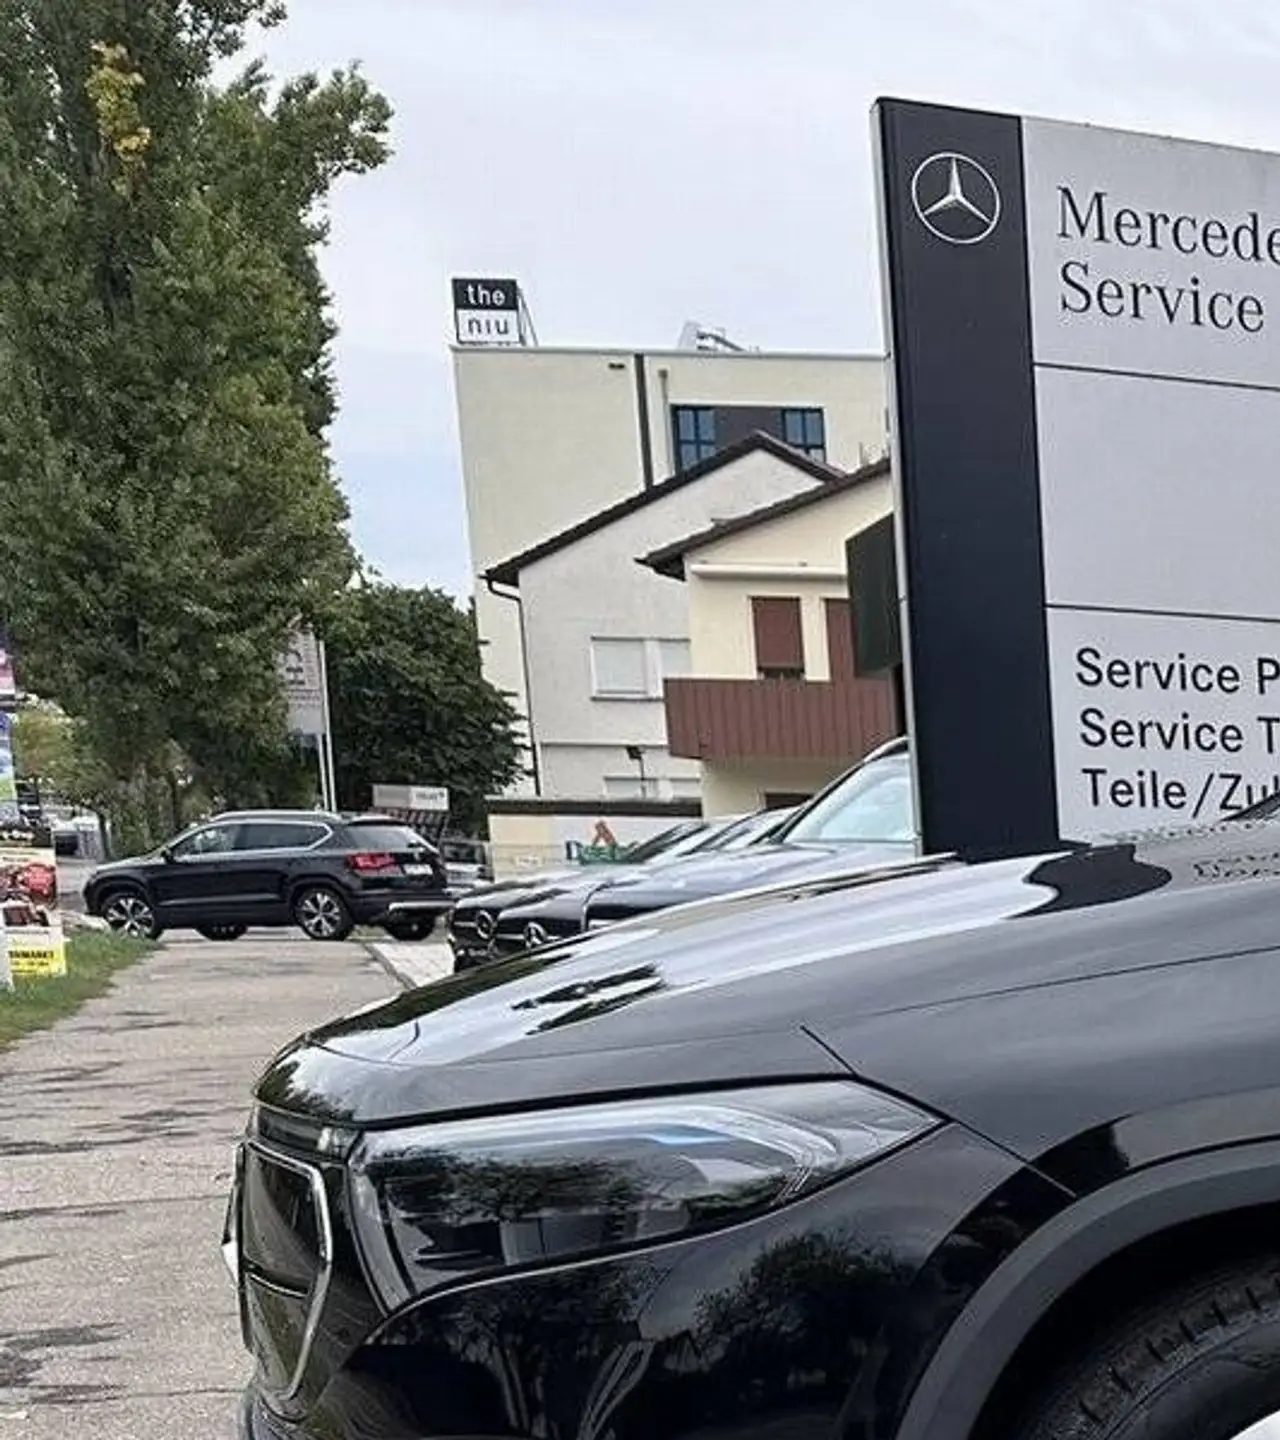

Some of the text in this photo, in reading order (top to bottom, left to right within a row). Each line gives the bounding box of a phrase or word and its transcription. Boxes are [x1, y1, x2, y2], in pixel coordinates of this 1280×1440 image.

[466, 283, 506, 306] the
[1060, 260, 1265, 334] Service
[467, 318, 510, 335] niu
[1075, 647, 1241, 693] Service
[1079, 708, 1244, 753] Service
